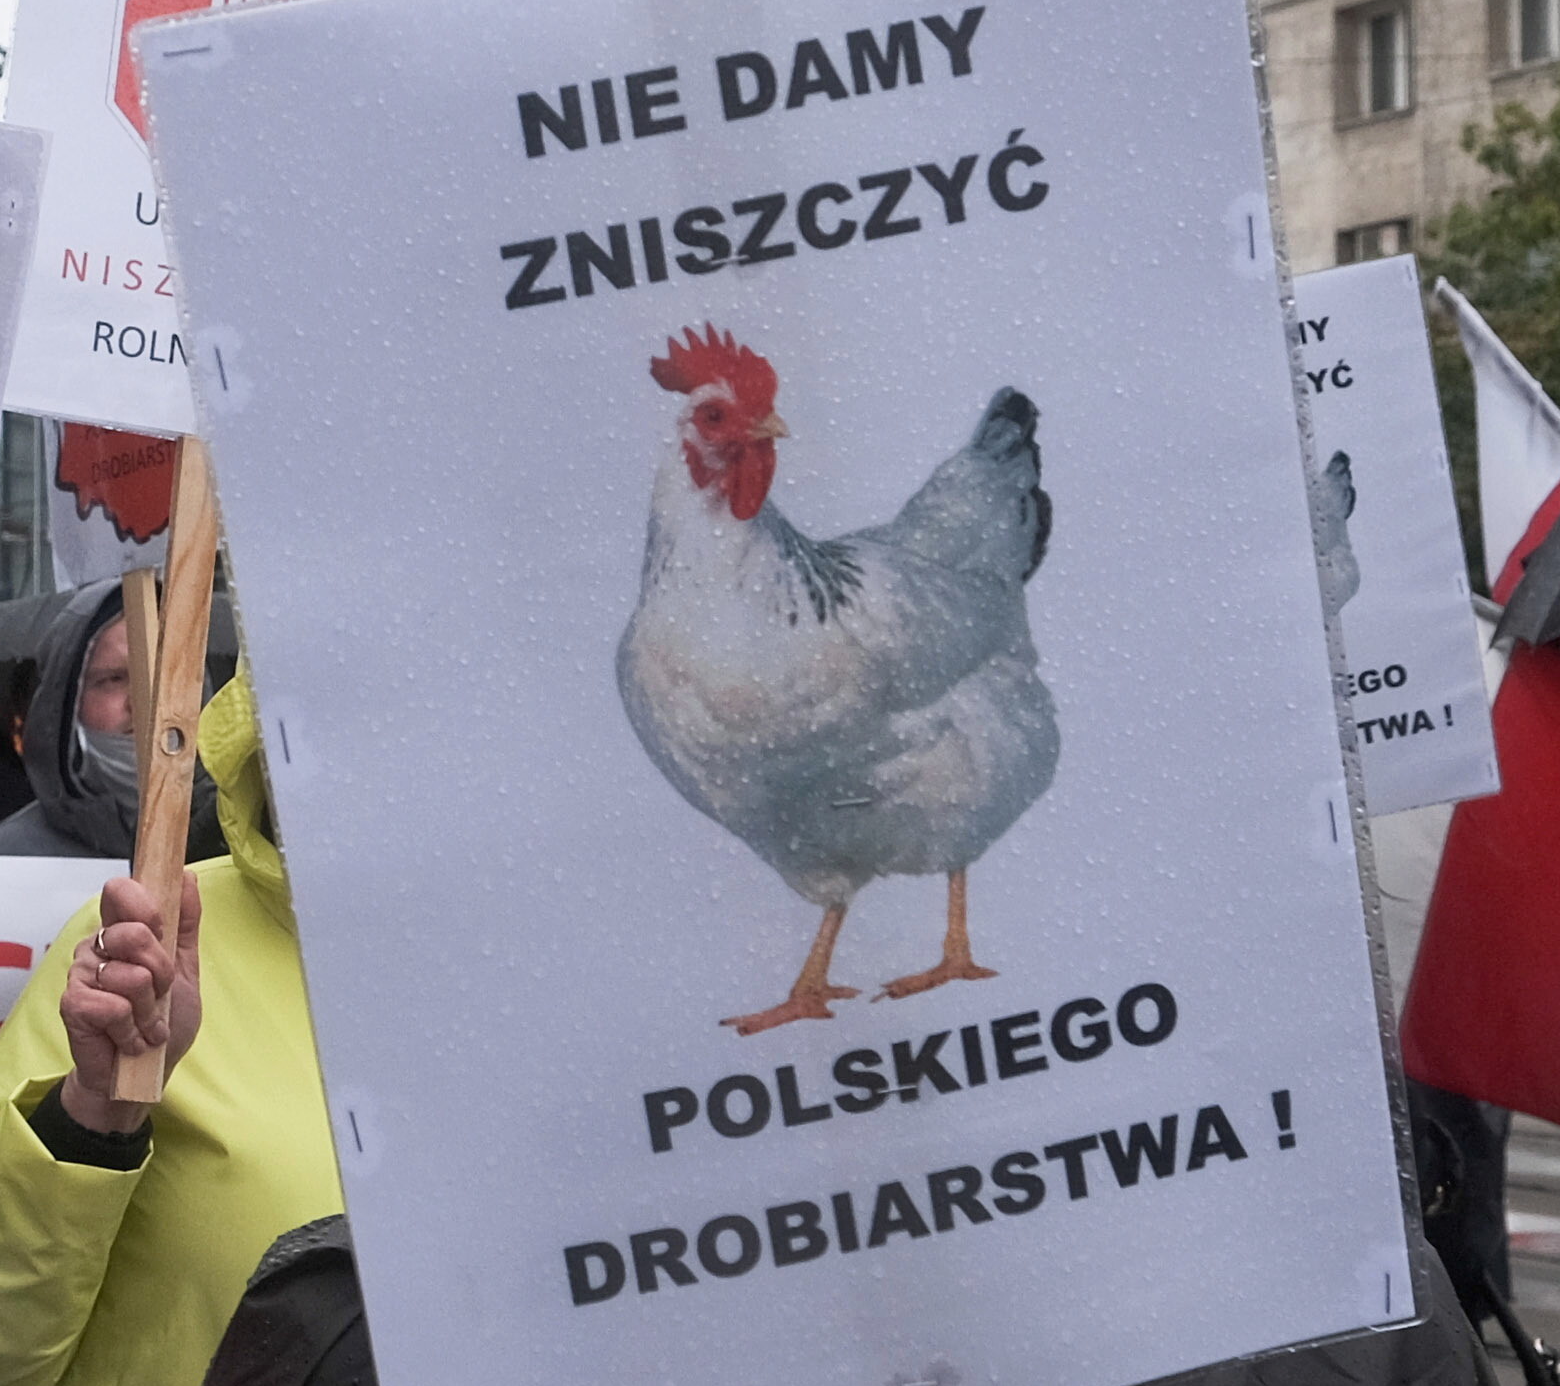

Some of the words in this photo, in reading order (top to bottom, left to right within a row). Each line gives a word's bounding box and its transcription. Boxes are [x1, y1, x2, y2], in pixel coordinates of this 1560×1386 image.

[517, 67, 683, 158] NIE
[718, 7, 989, 127] DAMY
[499, 127, 1052, 311] ZNISZCZYĆ
[91, 441, 172, 484] DROBIARST
[641, 982, 1180, 1153] POLSKIEGO
[562, 1109, 1248, 1307] DROBIARSTWA
